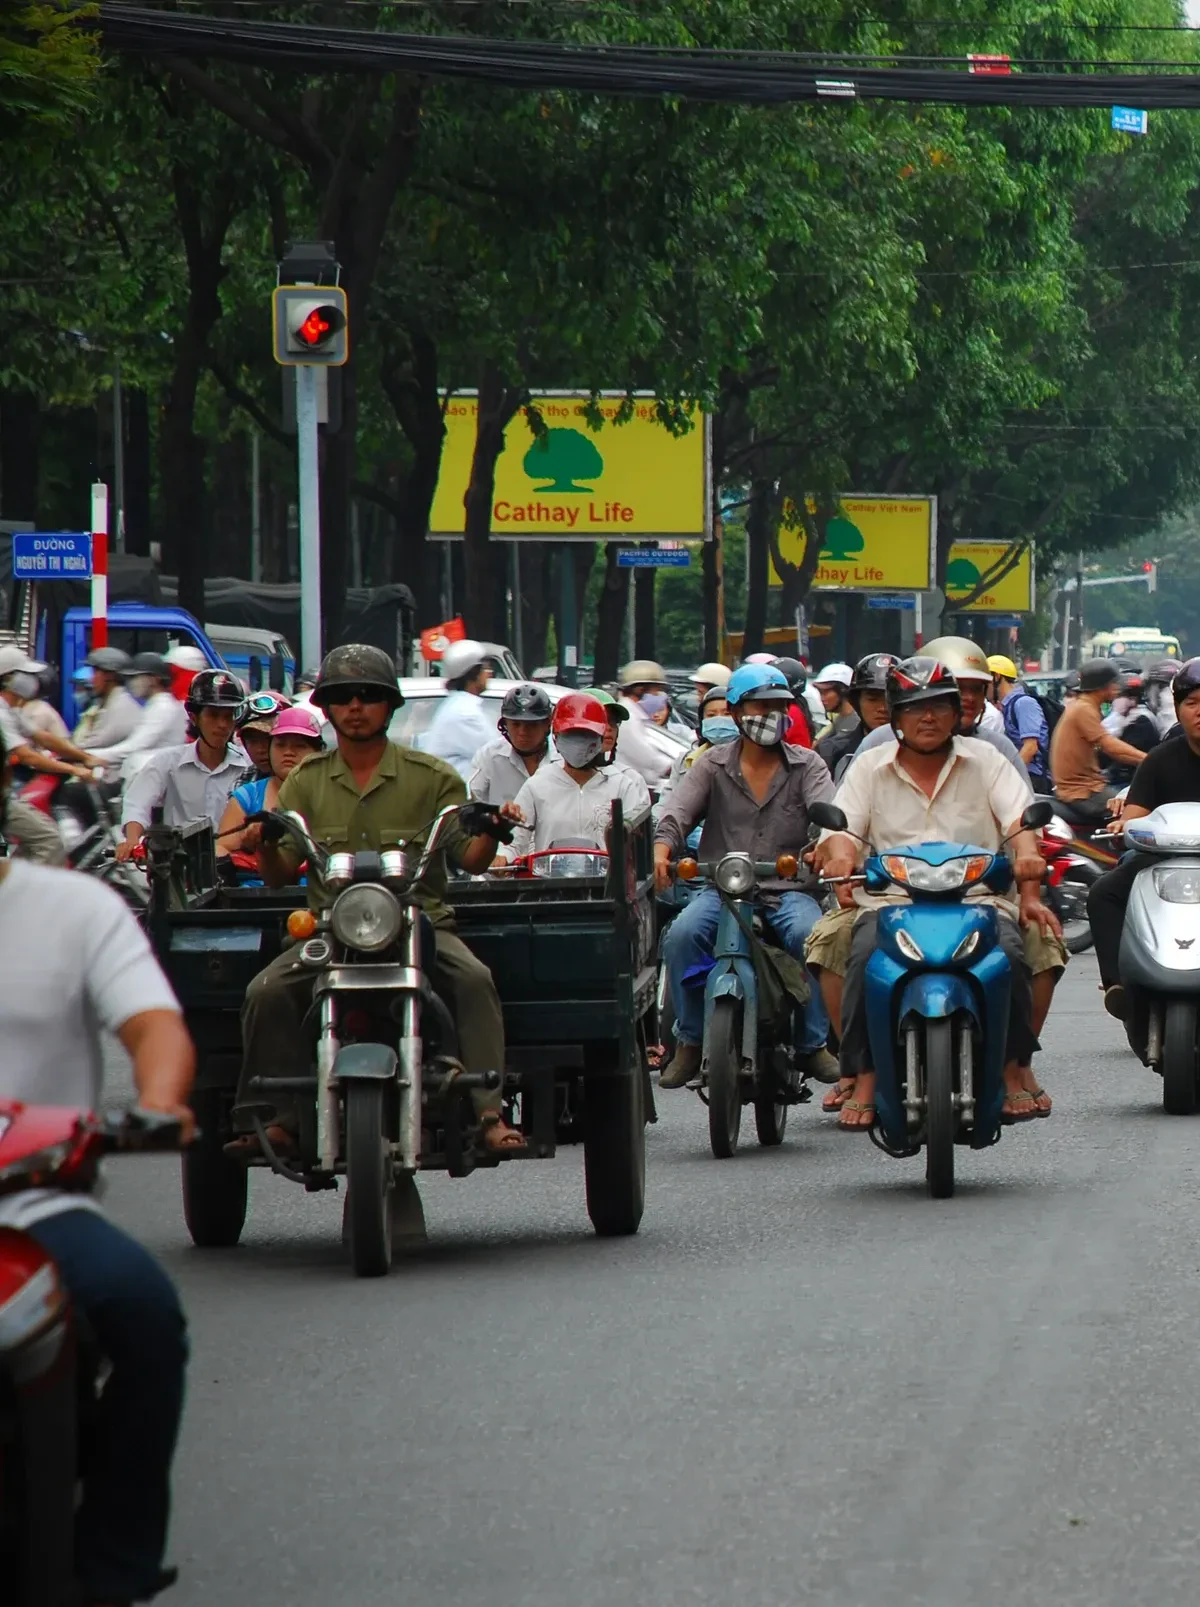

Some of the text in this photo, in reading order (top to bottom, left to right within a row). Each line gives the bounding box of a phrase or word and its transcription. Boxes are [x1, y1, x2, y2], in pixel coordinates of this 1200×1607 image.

[493, 501, 634, 527] Cathay Life
[845, 503, 876, 513] Cathay
[33, 537, 75, 550] ĐƯỜNG
[16, 552, 46, 570] NGUYỄN
[854, 568, 884, 580] Life
